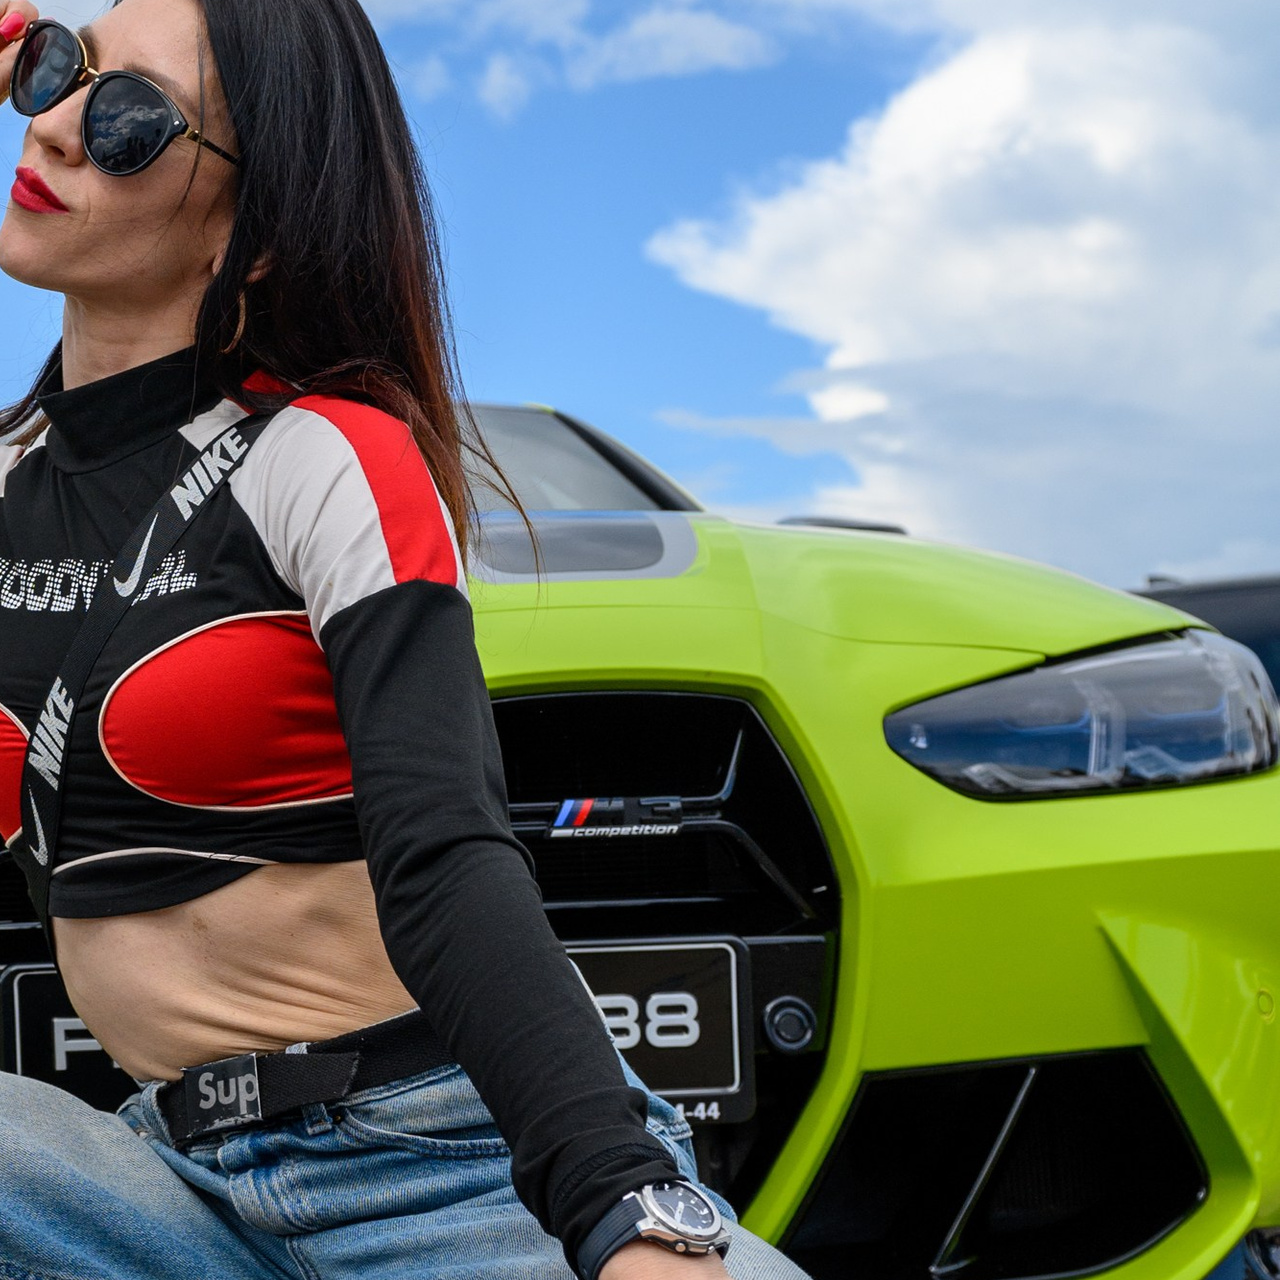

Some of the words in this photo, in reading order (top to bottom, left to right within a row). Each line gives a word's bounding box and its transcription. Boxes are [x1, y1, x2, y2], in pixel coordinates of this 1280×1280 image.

[170, 426, 250, 522] NIKE
[28, 675, 75, 792] NIKE
[574, 824, 680, 838] competition
[198, 1072, 259, 1116] Sup
